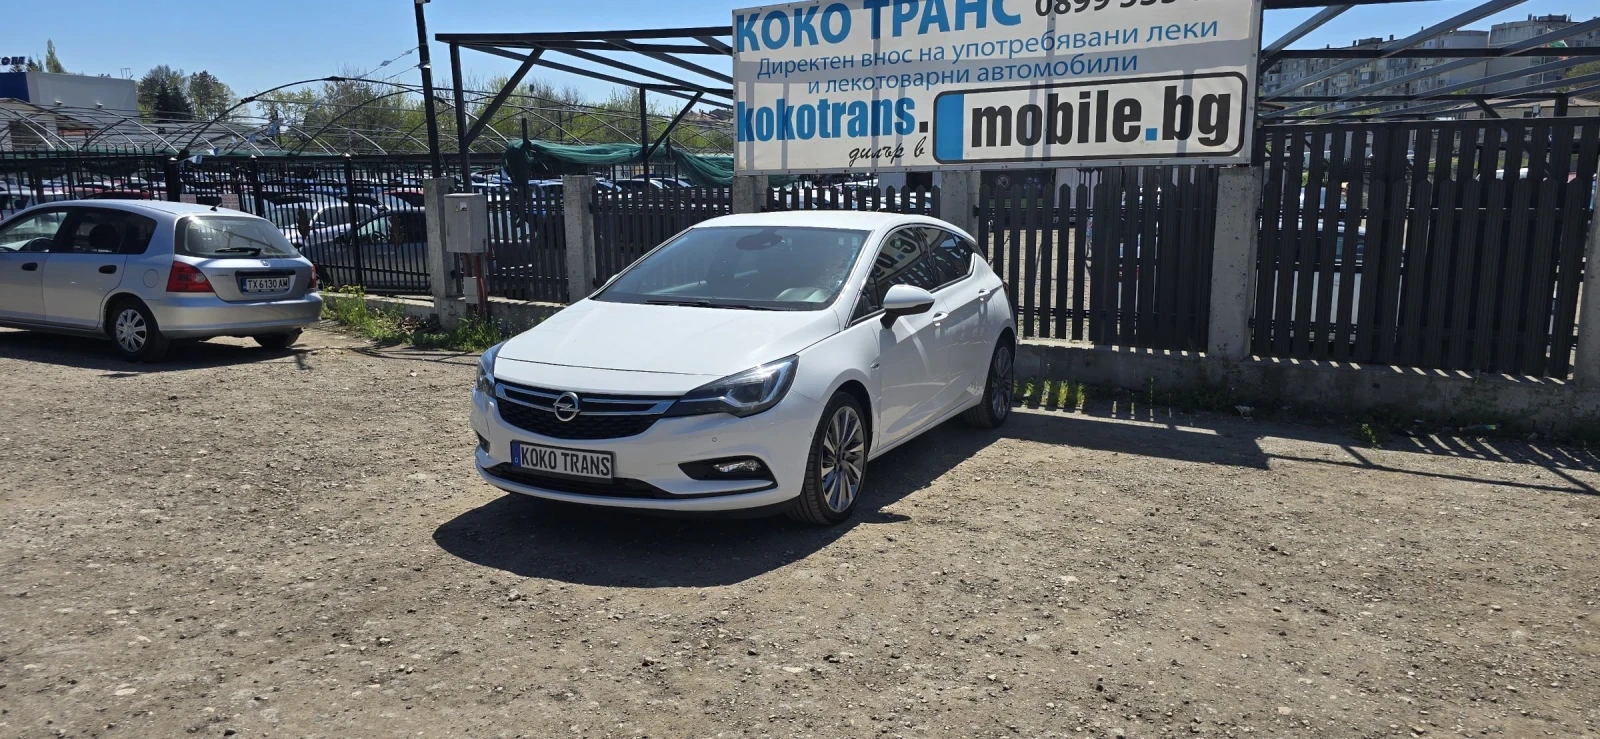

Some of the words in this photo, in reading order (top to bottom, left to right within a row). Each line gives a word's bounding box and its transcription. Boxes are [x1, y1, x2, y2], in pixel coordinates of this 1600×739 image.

[736, 2, 853, 53] КОКО
[864, 0, 1022, 40] ТРАНС
[757, 53, 854, 80] Директен
[861, 48, 913, 68] внос
[919, 45, 945, 62] на
[952, 28, 1139, 65] употребявани
[1146, 20, 1218, 42] леки
[808, 80, 820, 95] и
[825, 68, 969, 94] лекотоварни
[977, 53, 1138, 82] автомобили
[971, 85, 1232, 147] mobile.bg
[247, 279, 258, 289] TX
[260, 279, 277, 289] 6130
[279, 278, 288, 288] AM
[521, 446, 557, 470] KOKO
[561, 452, 610, 477] TRANS
